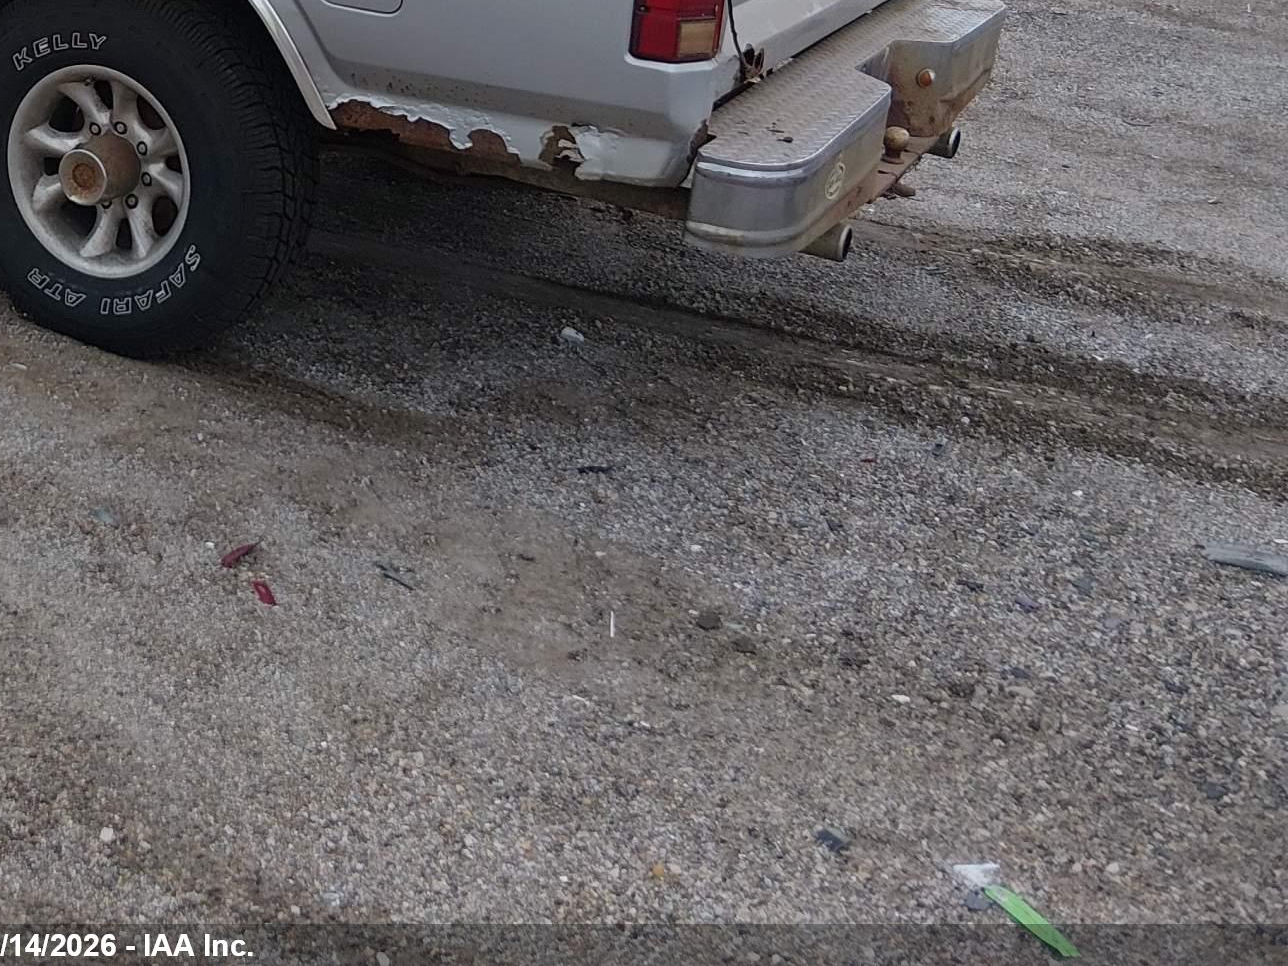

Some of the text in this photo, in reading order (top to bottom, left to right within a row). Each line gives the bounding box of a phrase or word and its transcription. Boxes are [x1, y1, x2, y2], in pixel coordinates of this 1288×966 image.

[12, 32, 108, 71] KELLY
[27, 245, 201, 315] SAFARI ATR
